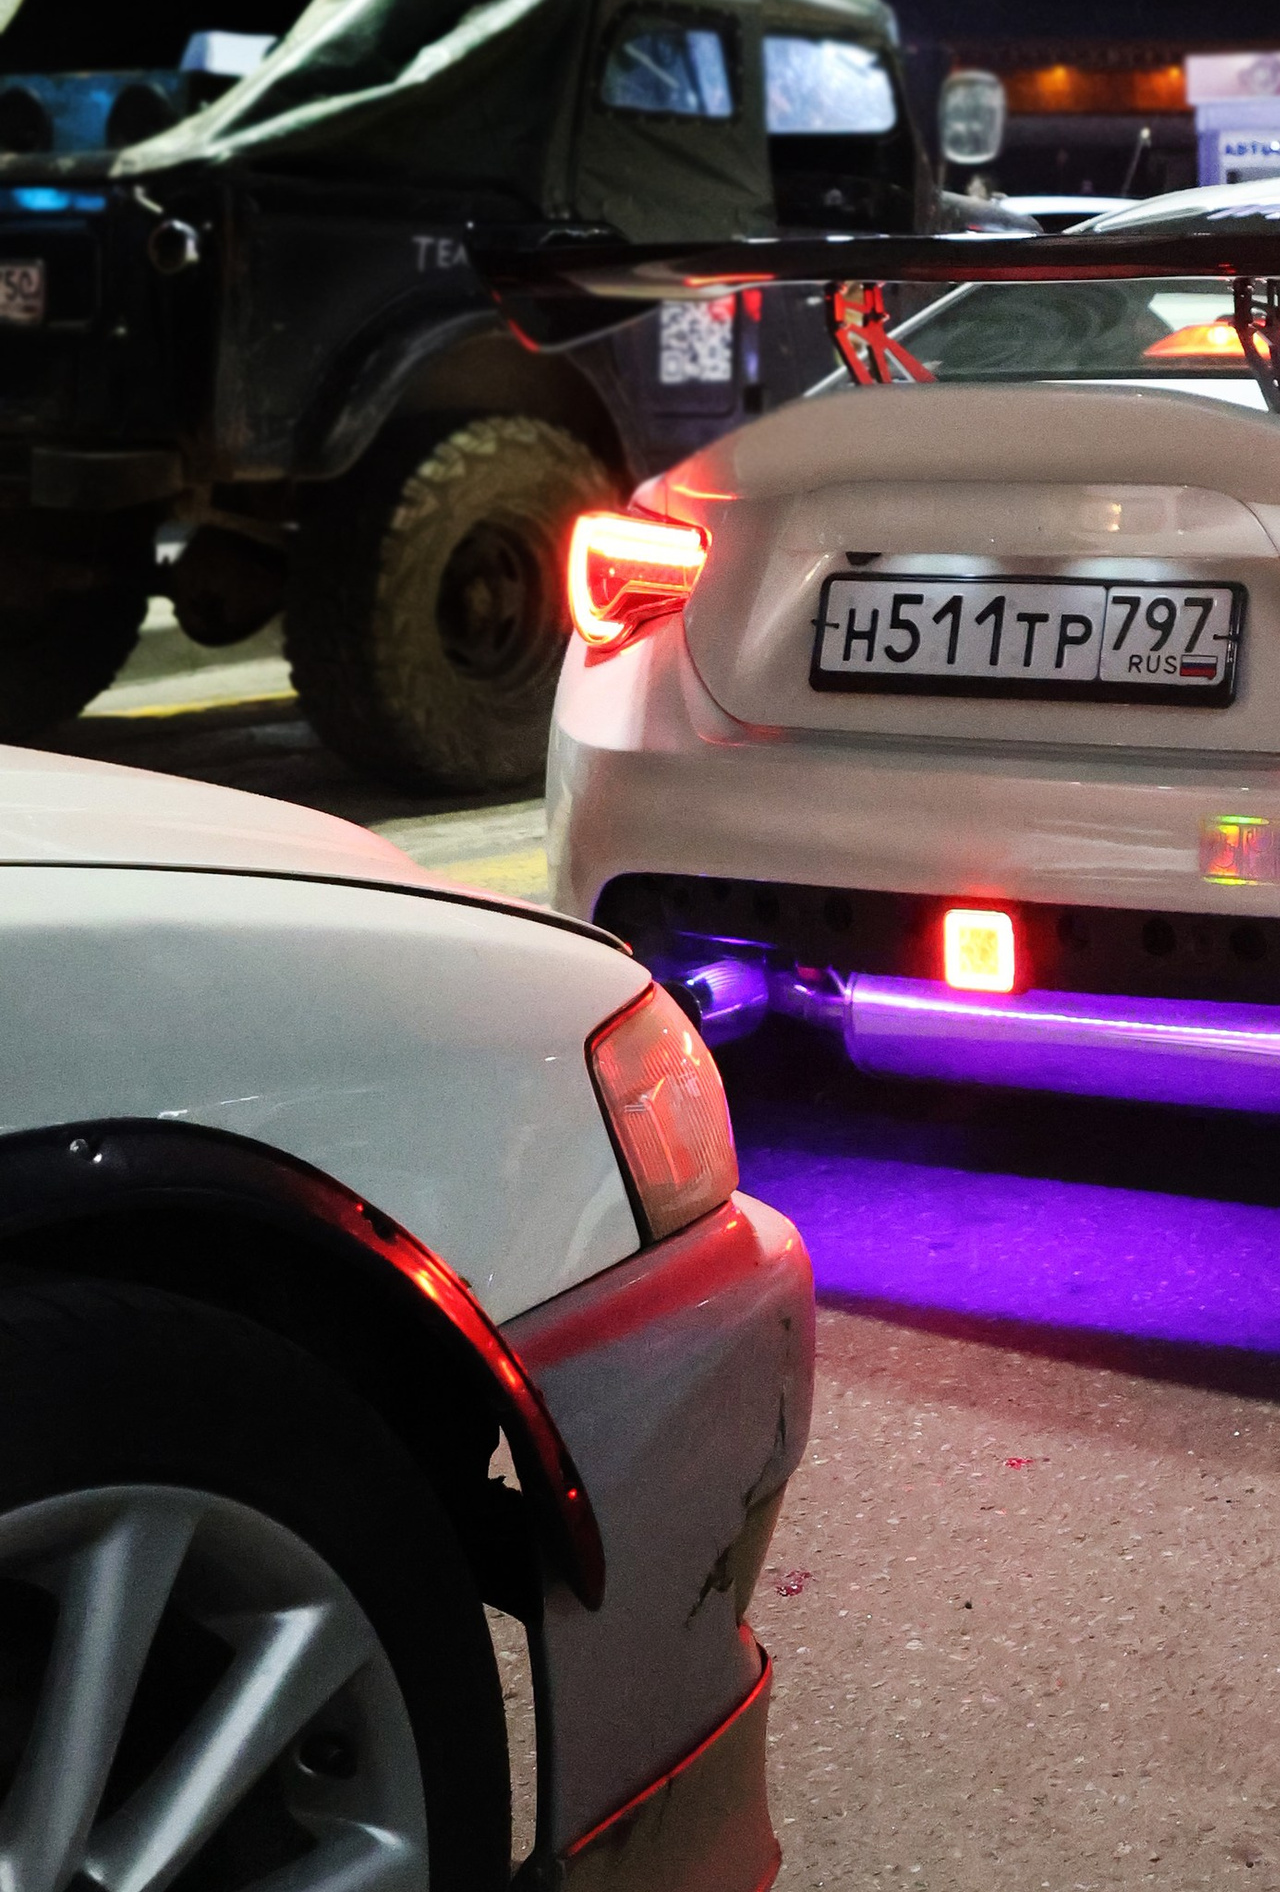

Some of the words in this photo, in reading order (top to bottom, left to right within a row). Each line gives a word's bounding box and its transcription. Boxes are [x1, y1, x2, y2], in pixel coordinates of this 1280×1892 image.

[842, 593, 1094, 669] Н511ТР
[1111, 595, 1215, 653] 797
[1127, 653, 1178, 675] RUS
